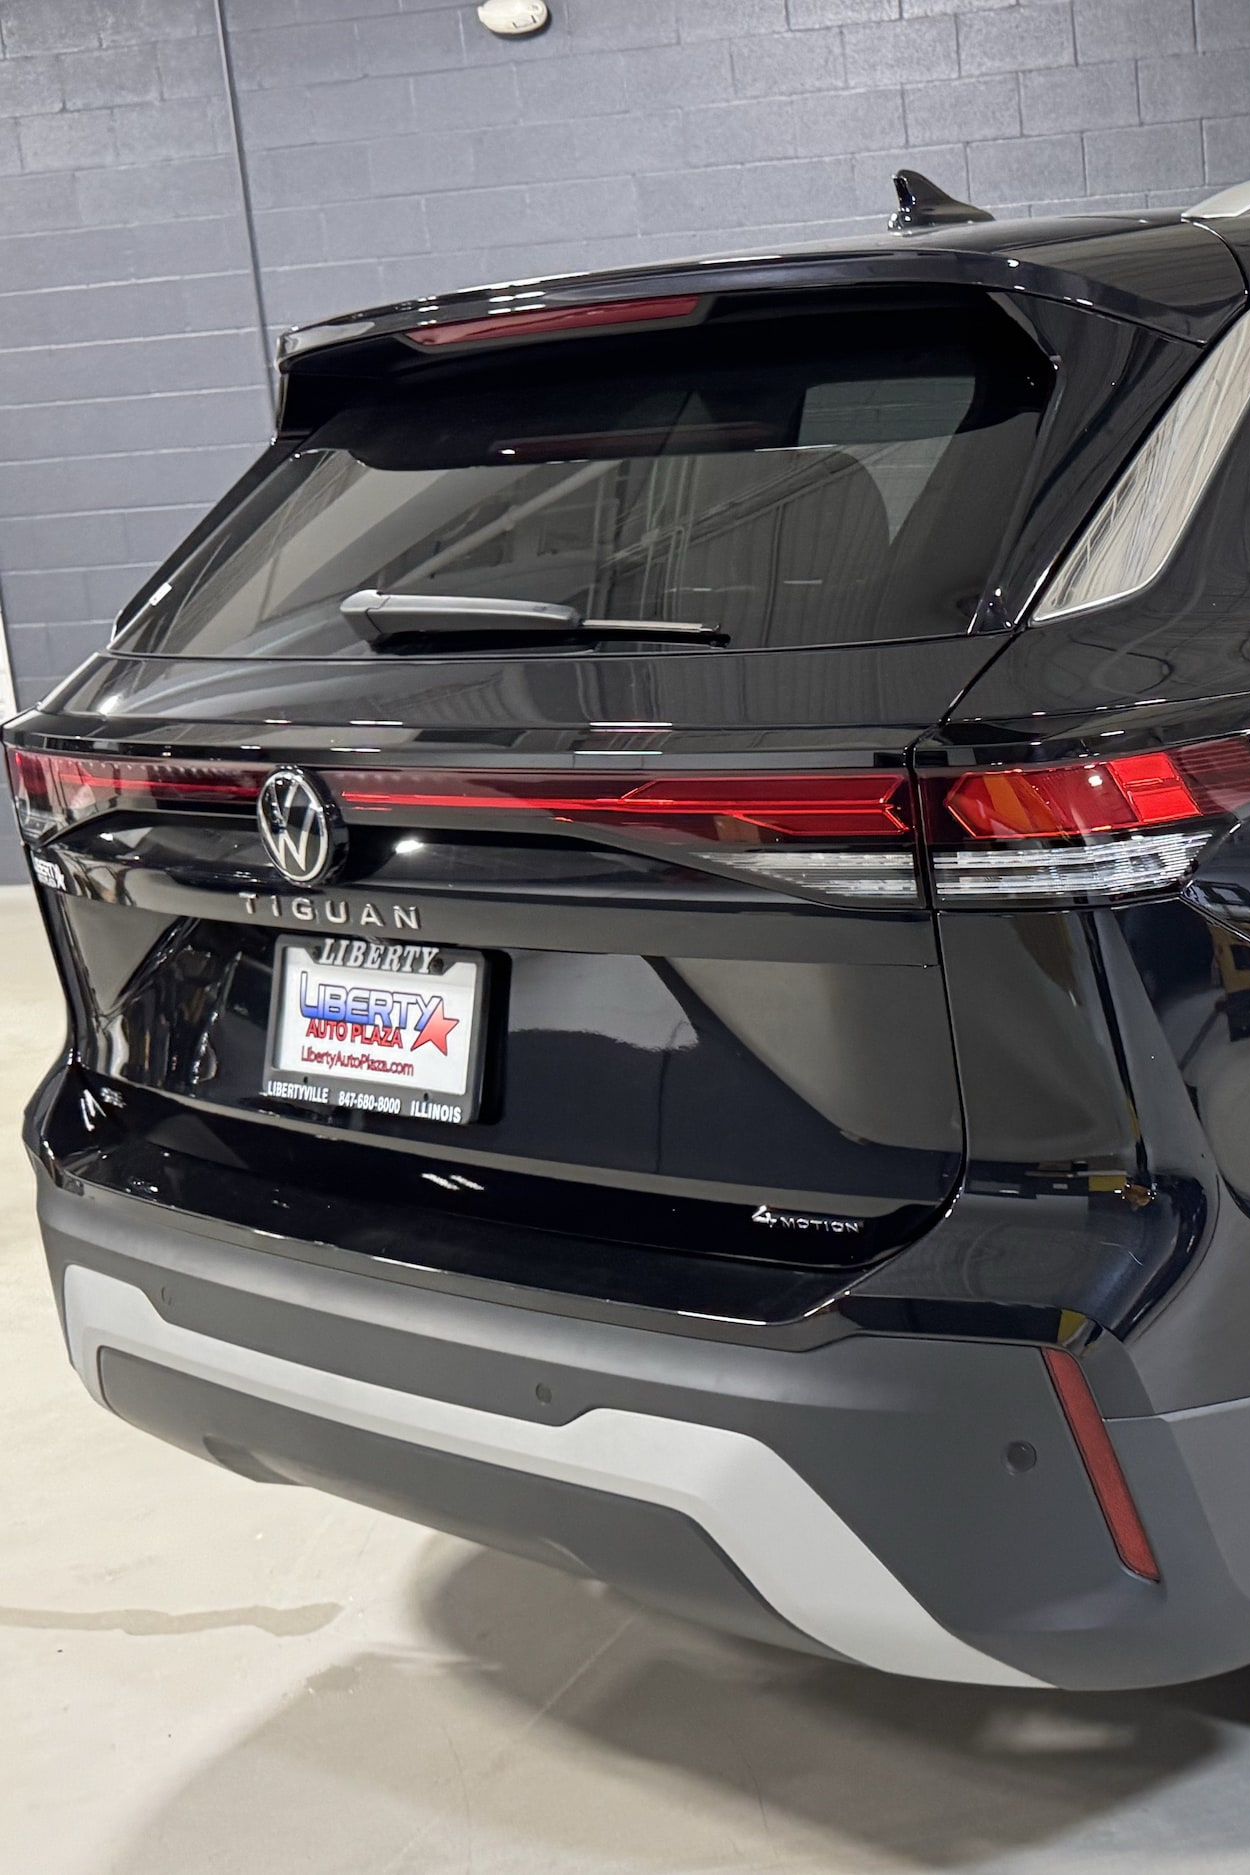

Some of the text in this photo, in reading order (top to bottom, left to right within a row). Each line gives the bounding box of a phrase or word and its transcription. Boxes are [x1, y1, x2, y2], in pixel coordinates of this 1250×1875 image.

[238, 891, 421, 930] TIGUAN
[318, 938, 440, 975] LIBERTY
[300, 970, 444, 1033] LIBERTY
[305, 1018, 404, 1049] AUTO PLAZA
[301, 1045, 415, 1077] LibertyAutoPlaza.com
[267, 1080, 468, 1124] LIBERTYVILLE 847-680-8000 ILLINOIS
[751, 1205, 860, 1233] 4MOTION
